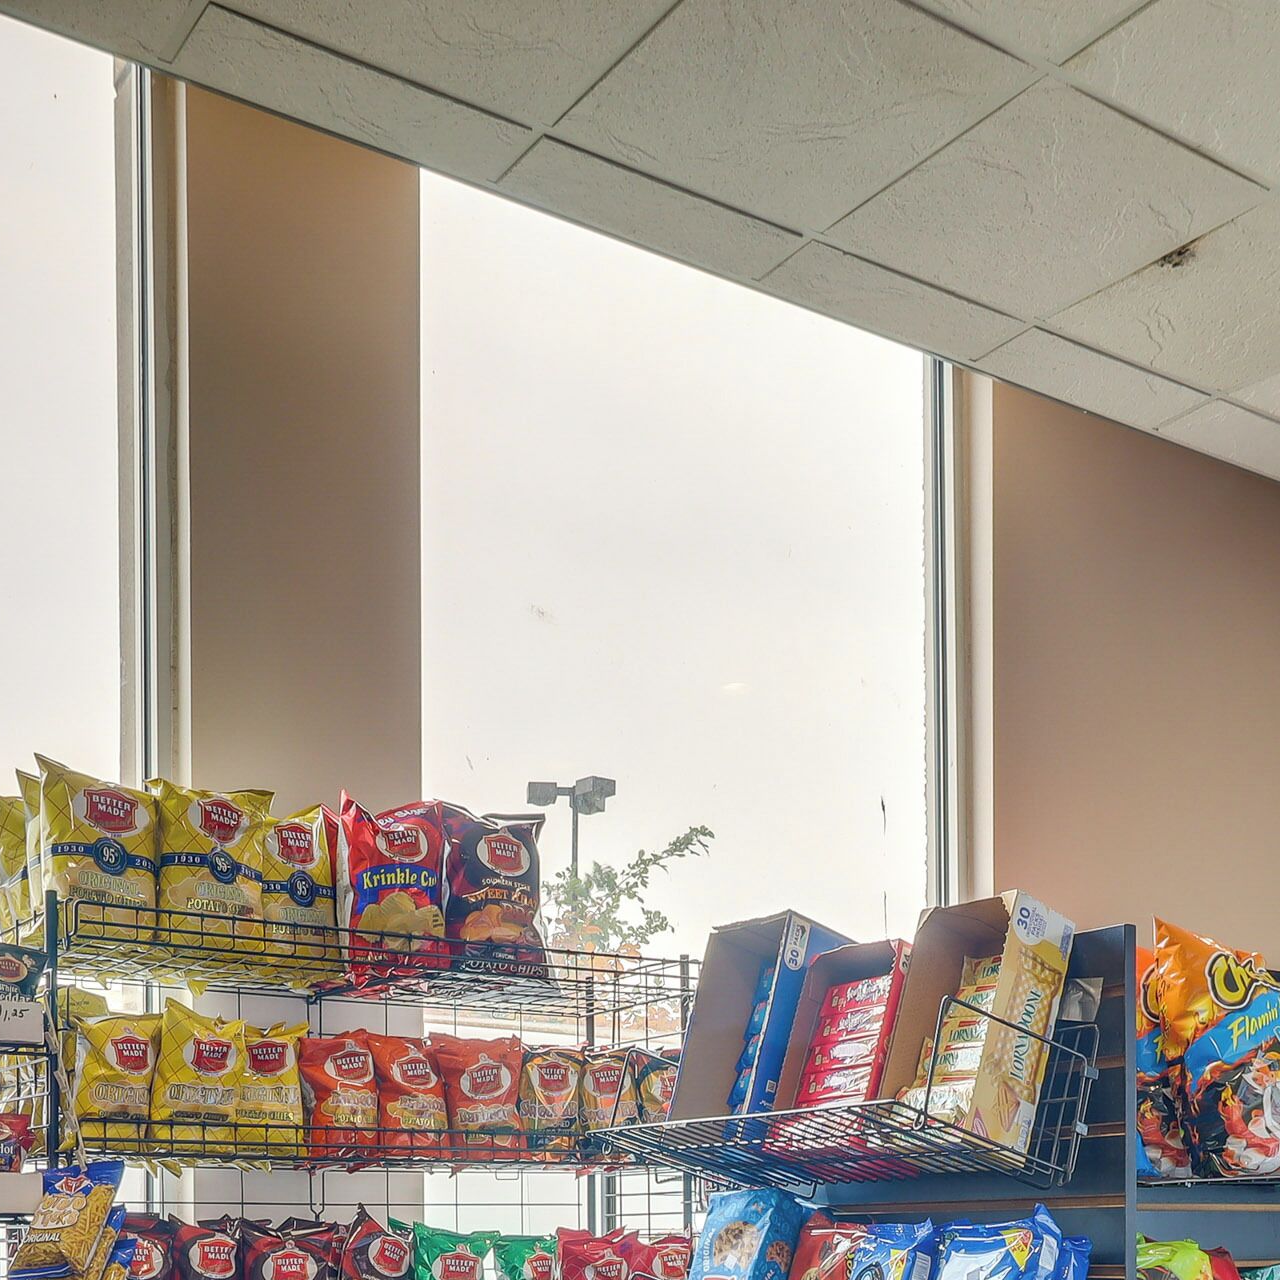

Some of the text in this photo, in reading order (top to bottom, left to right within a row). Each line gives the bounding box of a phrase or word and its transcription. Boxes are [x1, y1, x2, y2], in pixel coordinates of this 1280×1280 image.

[92, 794, 131, 812] BETTER
[98, 803, 126, 818] MADE
[206, 805, 240, 821] BETTER
[210, 813, 236, 826] MADE
[389, 829, 420, 839] BETTER
[394, 837, 417, 845] MADE
[363, 868, 417, 889] Krinkle
[1016, 905, 1031, 931] 30
[252, 1046, 284, 1054] BETTER
[1009, 1030, 1034, 1081] LORNA
[23, 1232, 62, 1243] ORIGINAL
